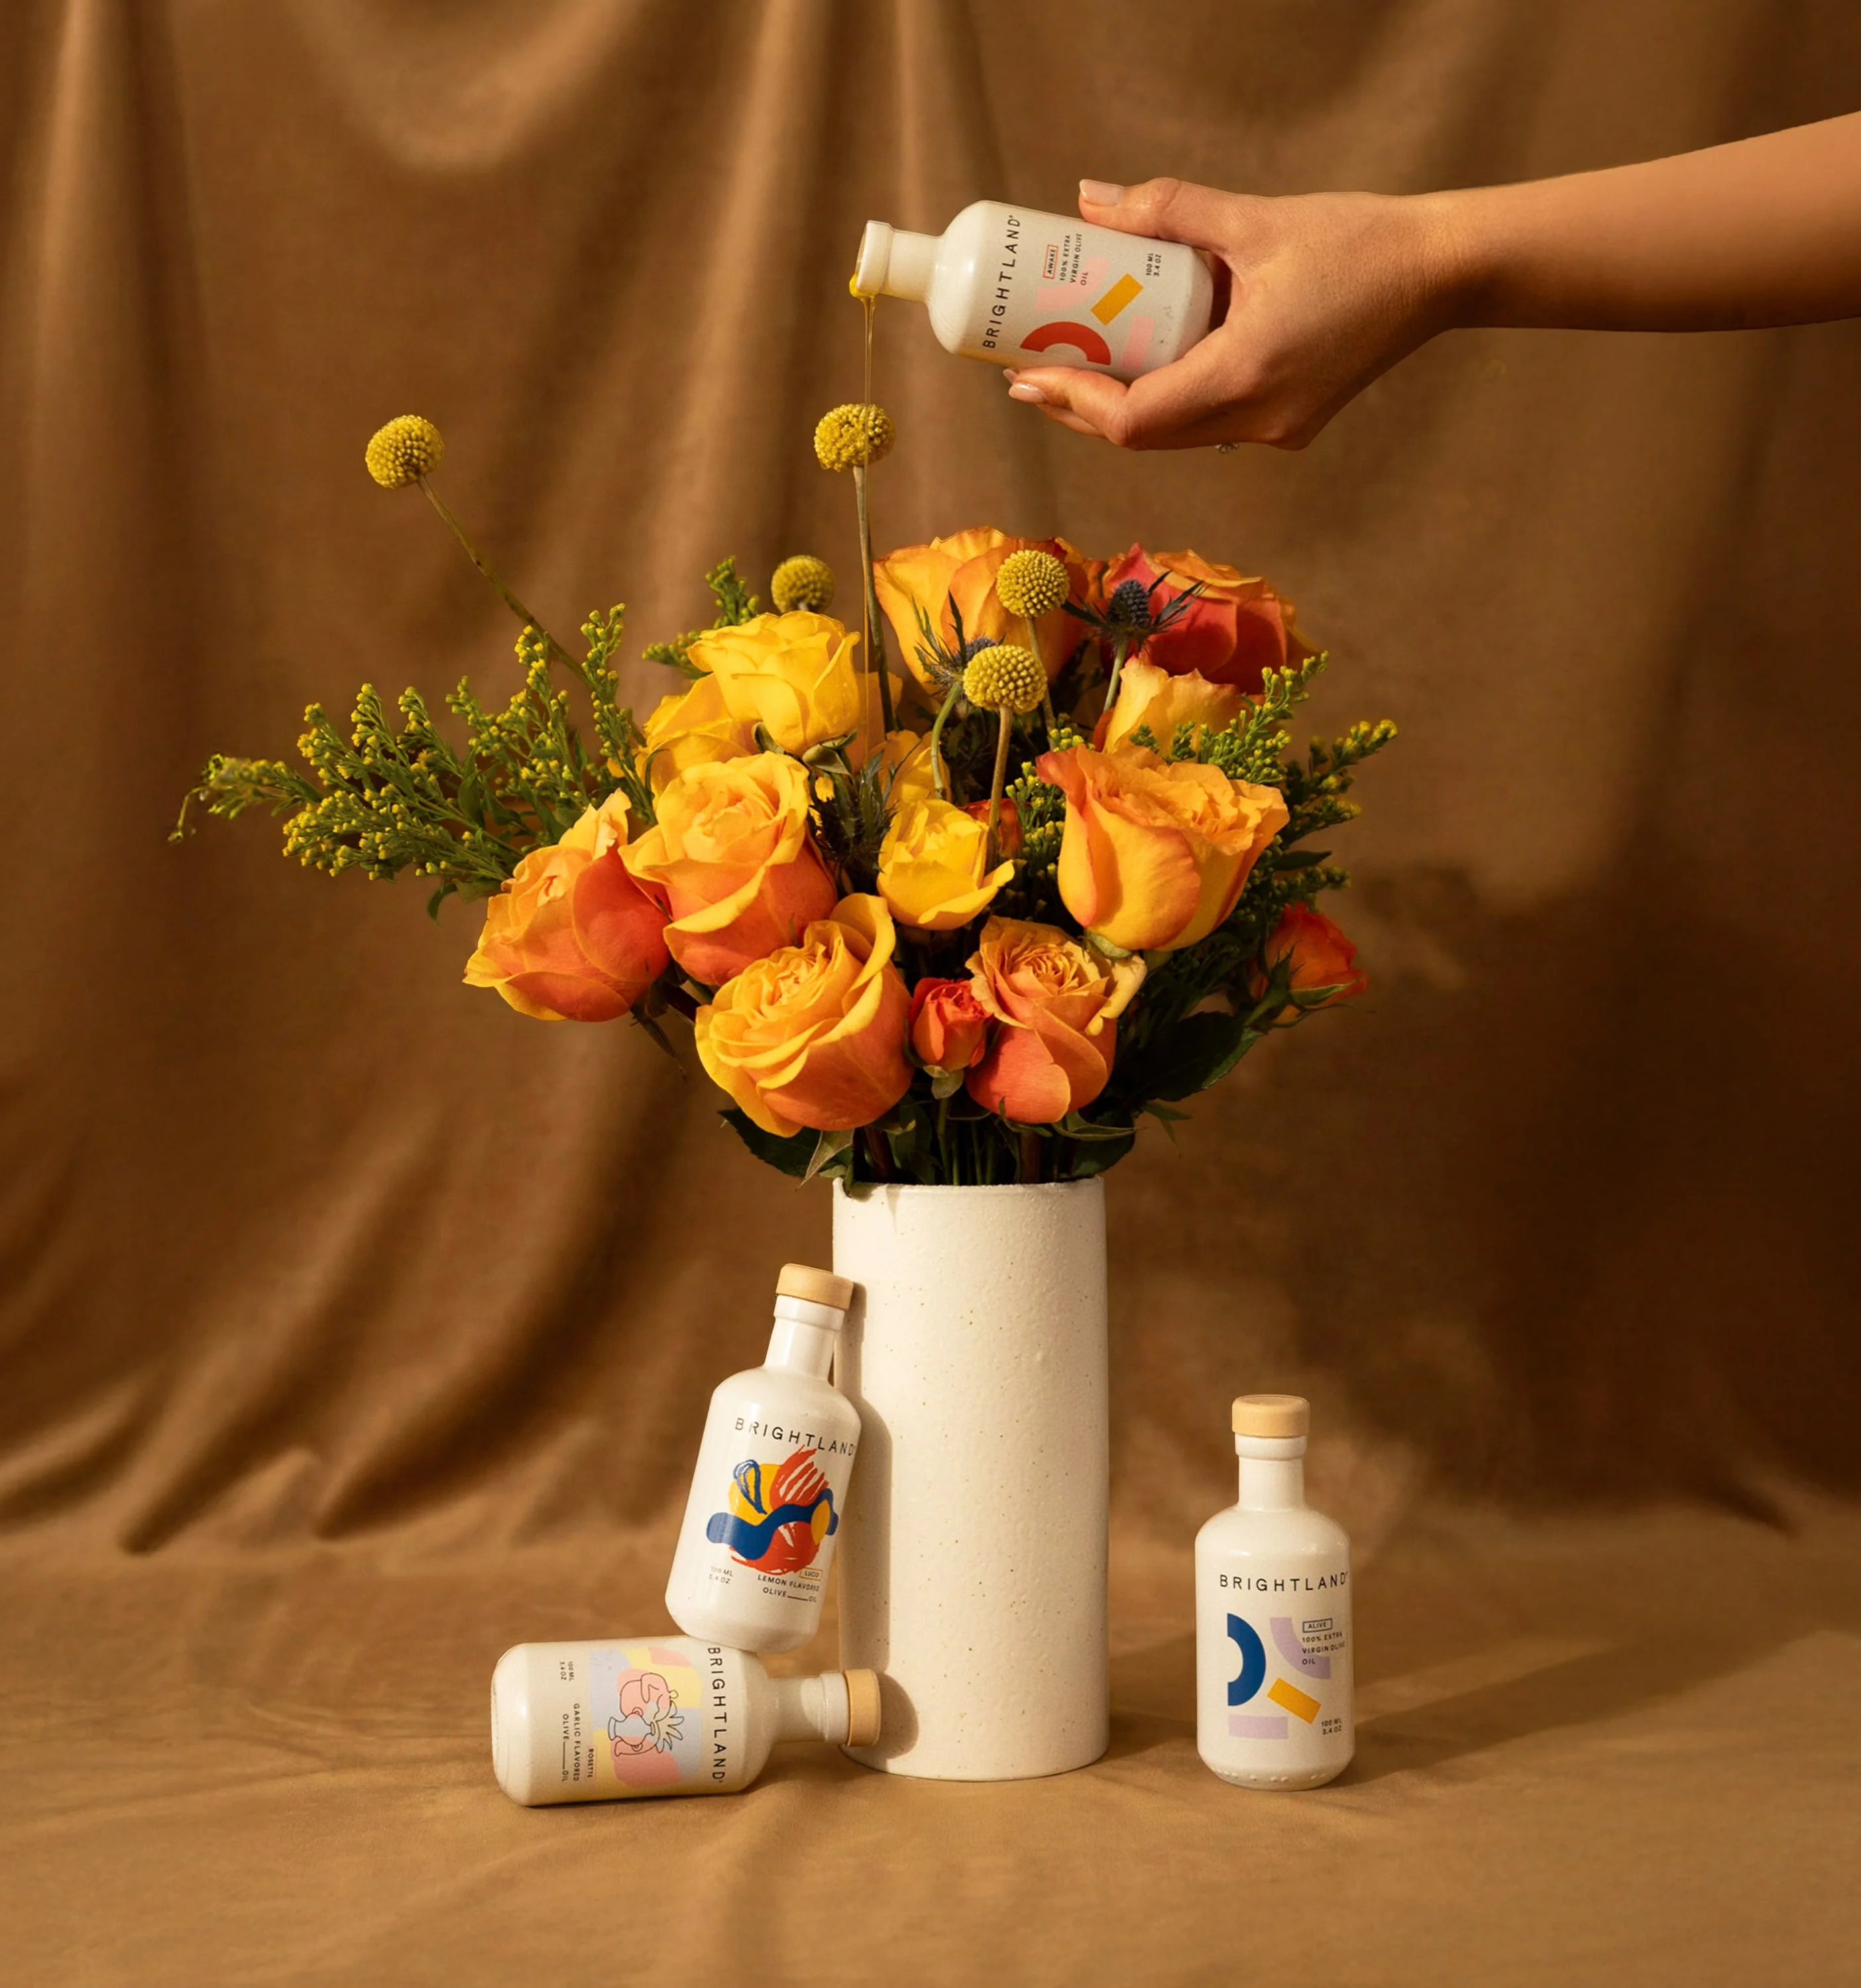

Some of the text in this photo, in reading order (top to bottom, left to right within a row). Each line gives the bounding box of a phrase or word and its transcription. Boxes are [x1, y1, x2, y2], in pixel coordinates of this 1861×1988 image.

[1047, 249, 1056, 274] AWAKE
[1147, 252, 1154, 262] ML
[1155, 254, 1161, 263] OZ
[1059, 260, 1068, 280] 100%
[1070, 254, 1080, 283] VIRGIN
[983, 218, 1021, 349] BRIGHTLAND
[1080, 271, 1089, 286] OIL
[734, 1417, 855, 1457] BRIGHTLAND
[758, 1574, 787, 1586] LEMON
[1219, 1573, 1347, 1592] BRIGHTLAND
[762, 1586, 787, 1597] OLIVE
[1324, 1631, 1342, 1641] EXTRA
[1302, 1645, 1329, 1654] VIRGIN
[561, 1671, 567, 1681] OZ
[569, 1672, 574, 1681] ML
[708, 1647, 727, 1781] BRIGHTLAND
